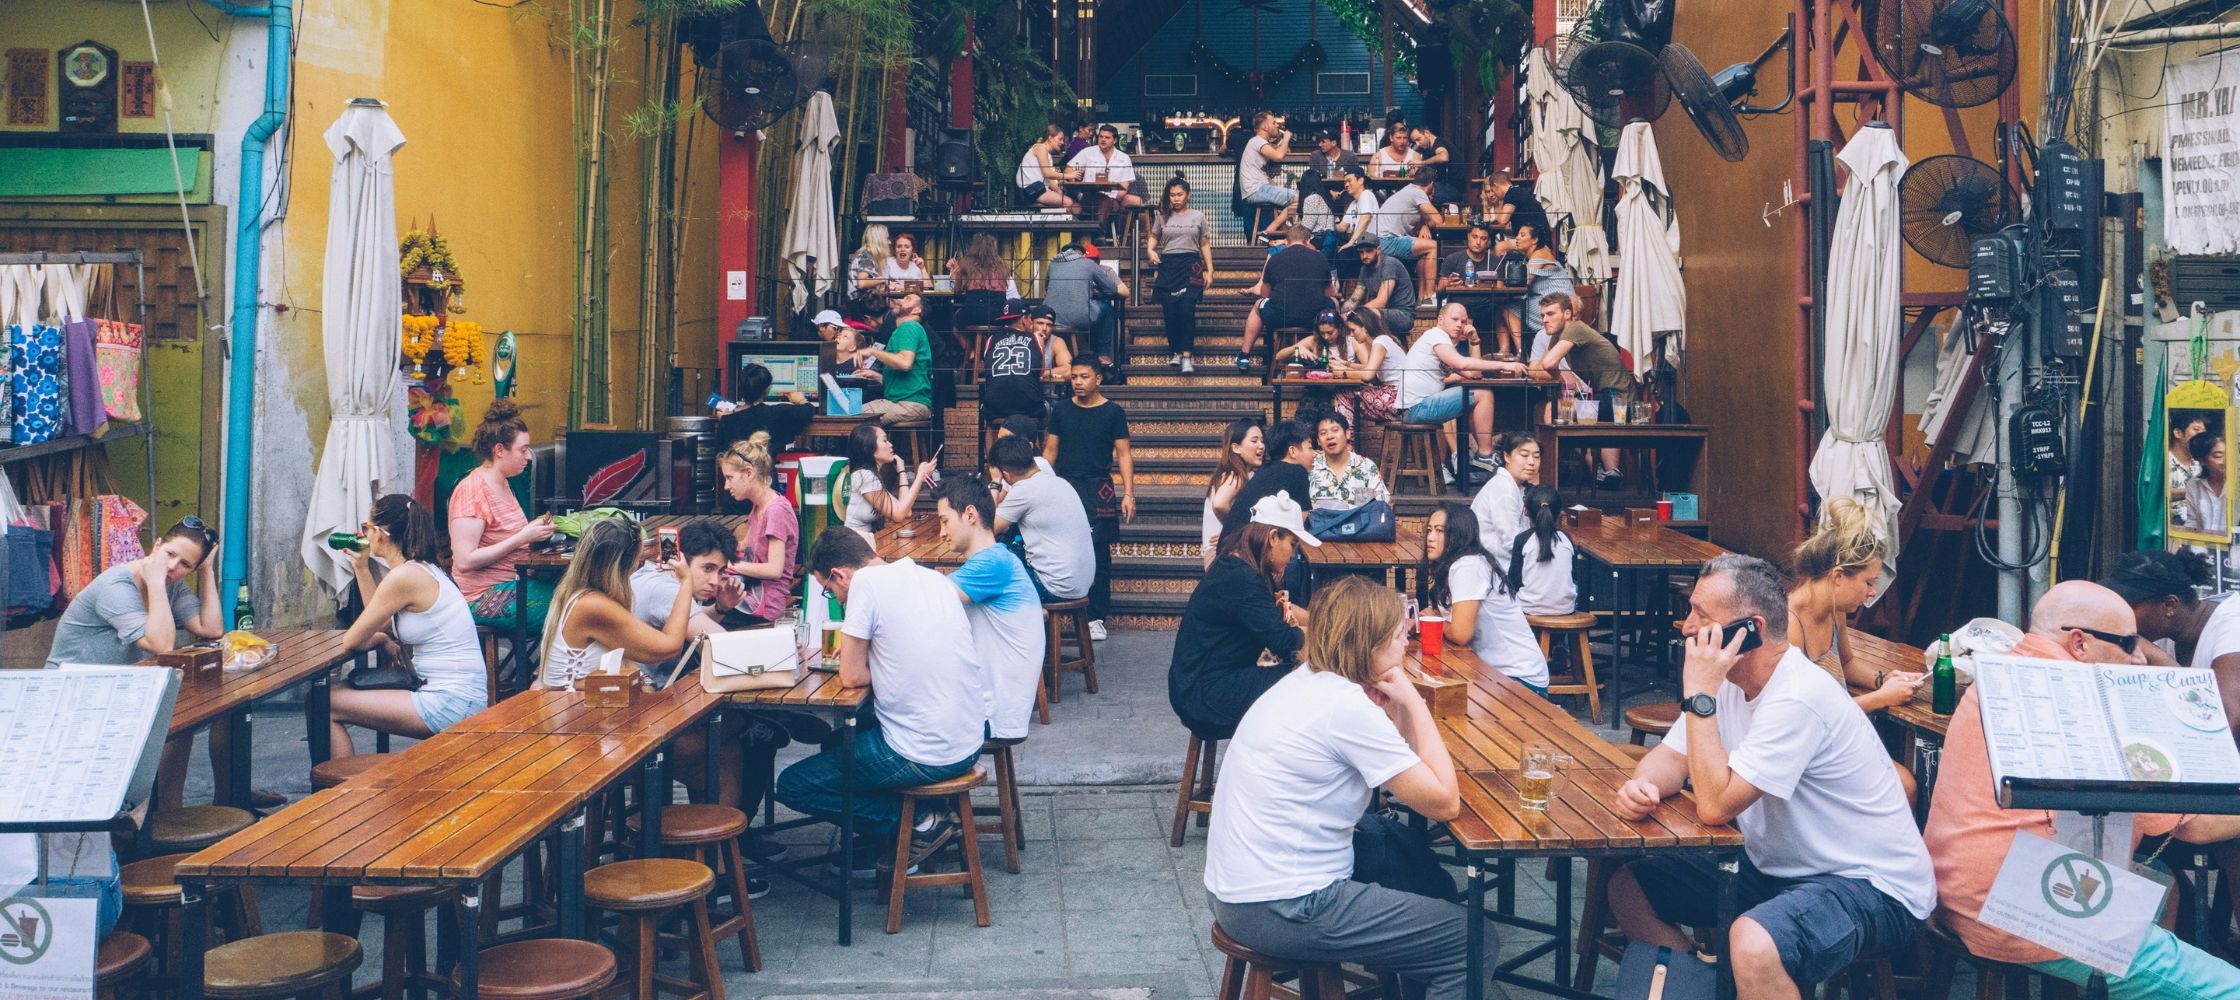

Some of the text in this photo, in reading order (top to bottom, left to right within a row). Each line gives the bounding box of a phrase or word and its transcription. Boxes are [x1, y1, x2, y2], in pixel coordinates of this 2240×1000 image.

[992, 346, 1031, 377] 23
[2103, 670, 2147, 690] Soup
[2157, 671, 2213, 688] Curry
